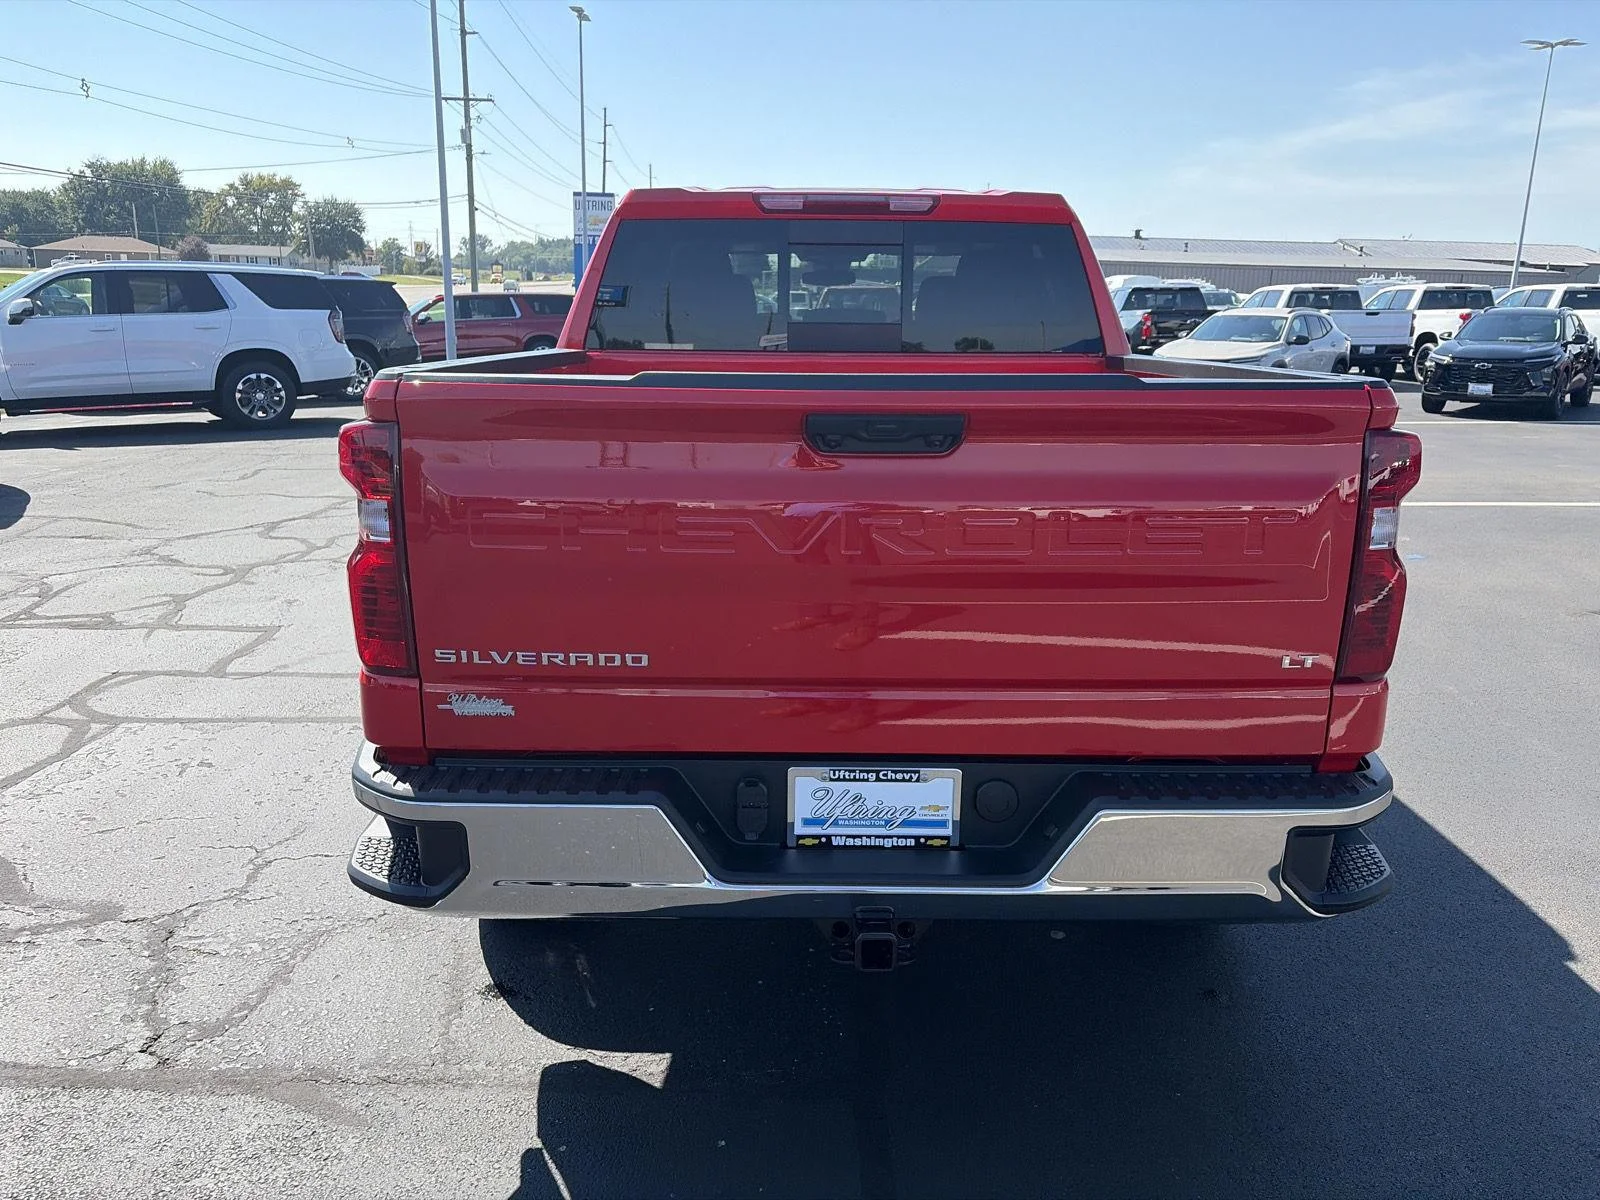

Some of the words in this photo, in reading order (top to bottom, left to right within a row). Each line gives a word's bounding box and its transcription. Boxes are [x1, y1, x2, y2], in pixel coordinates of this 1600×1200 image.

[574, 200, 613, 212] UTRING
[467, 509, 1299, 556] CHEVROLET
[434, 649, 649, 667] SILVERADO
[1281, 655, 1320, 669] LT
[829, 770, 877, 782] Uftring
[878, 770, 919, 782] Chevy
[810, 786, 917, 832] Uftring
[838, 818, 886, 827] WASHINGTON
[831, 836, 915, 848] Washington
